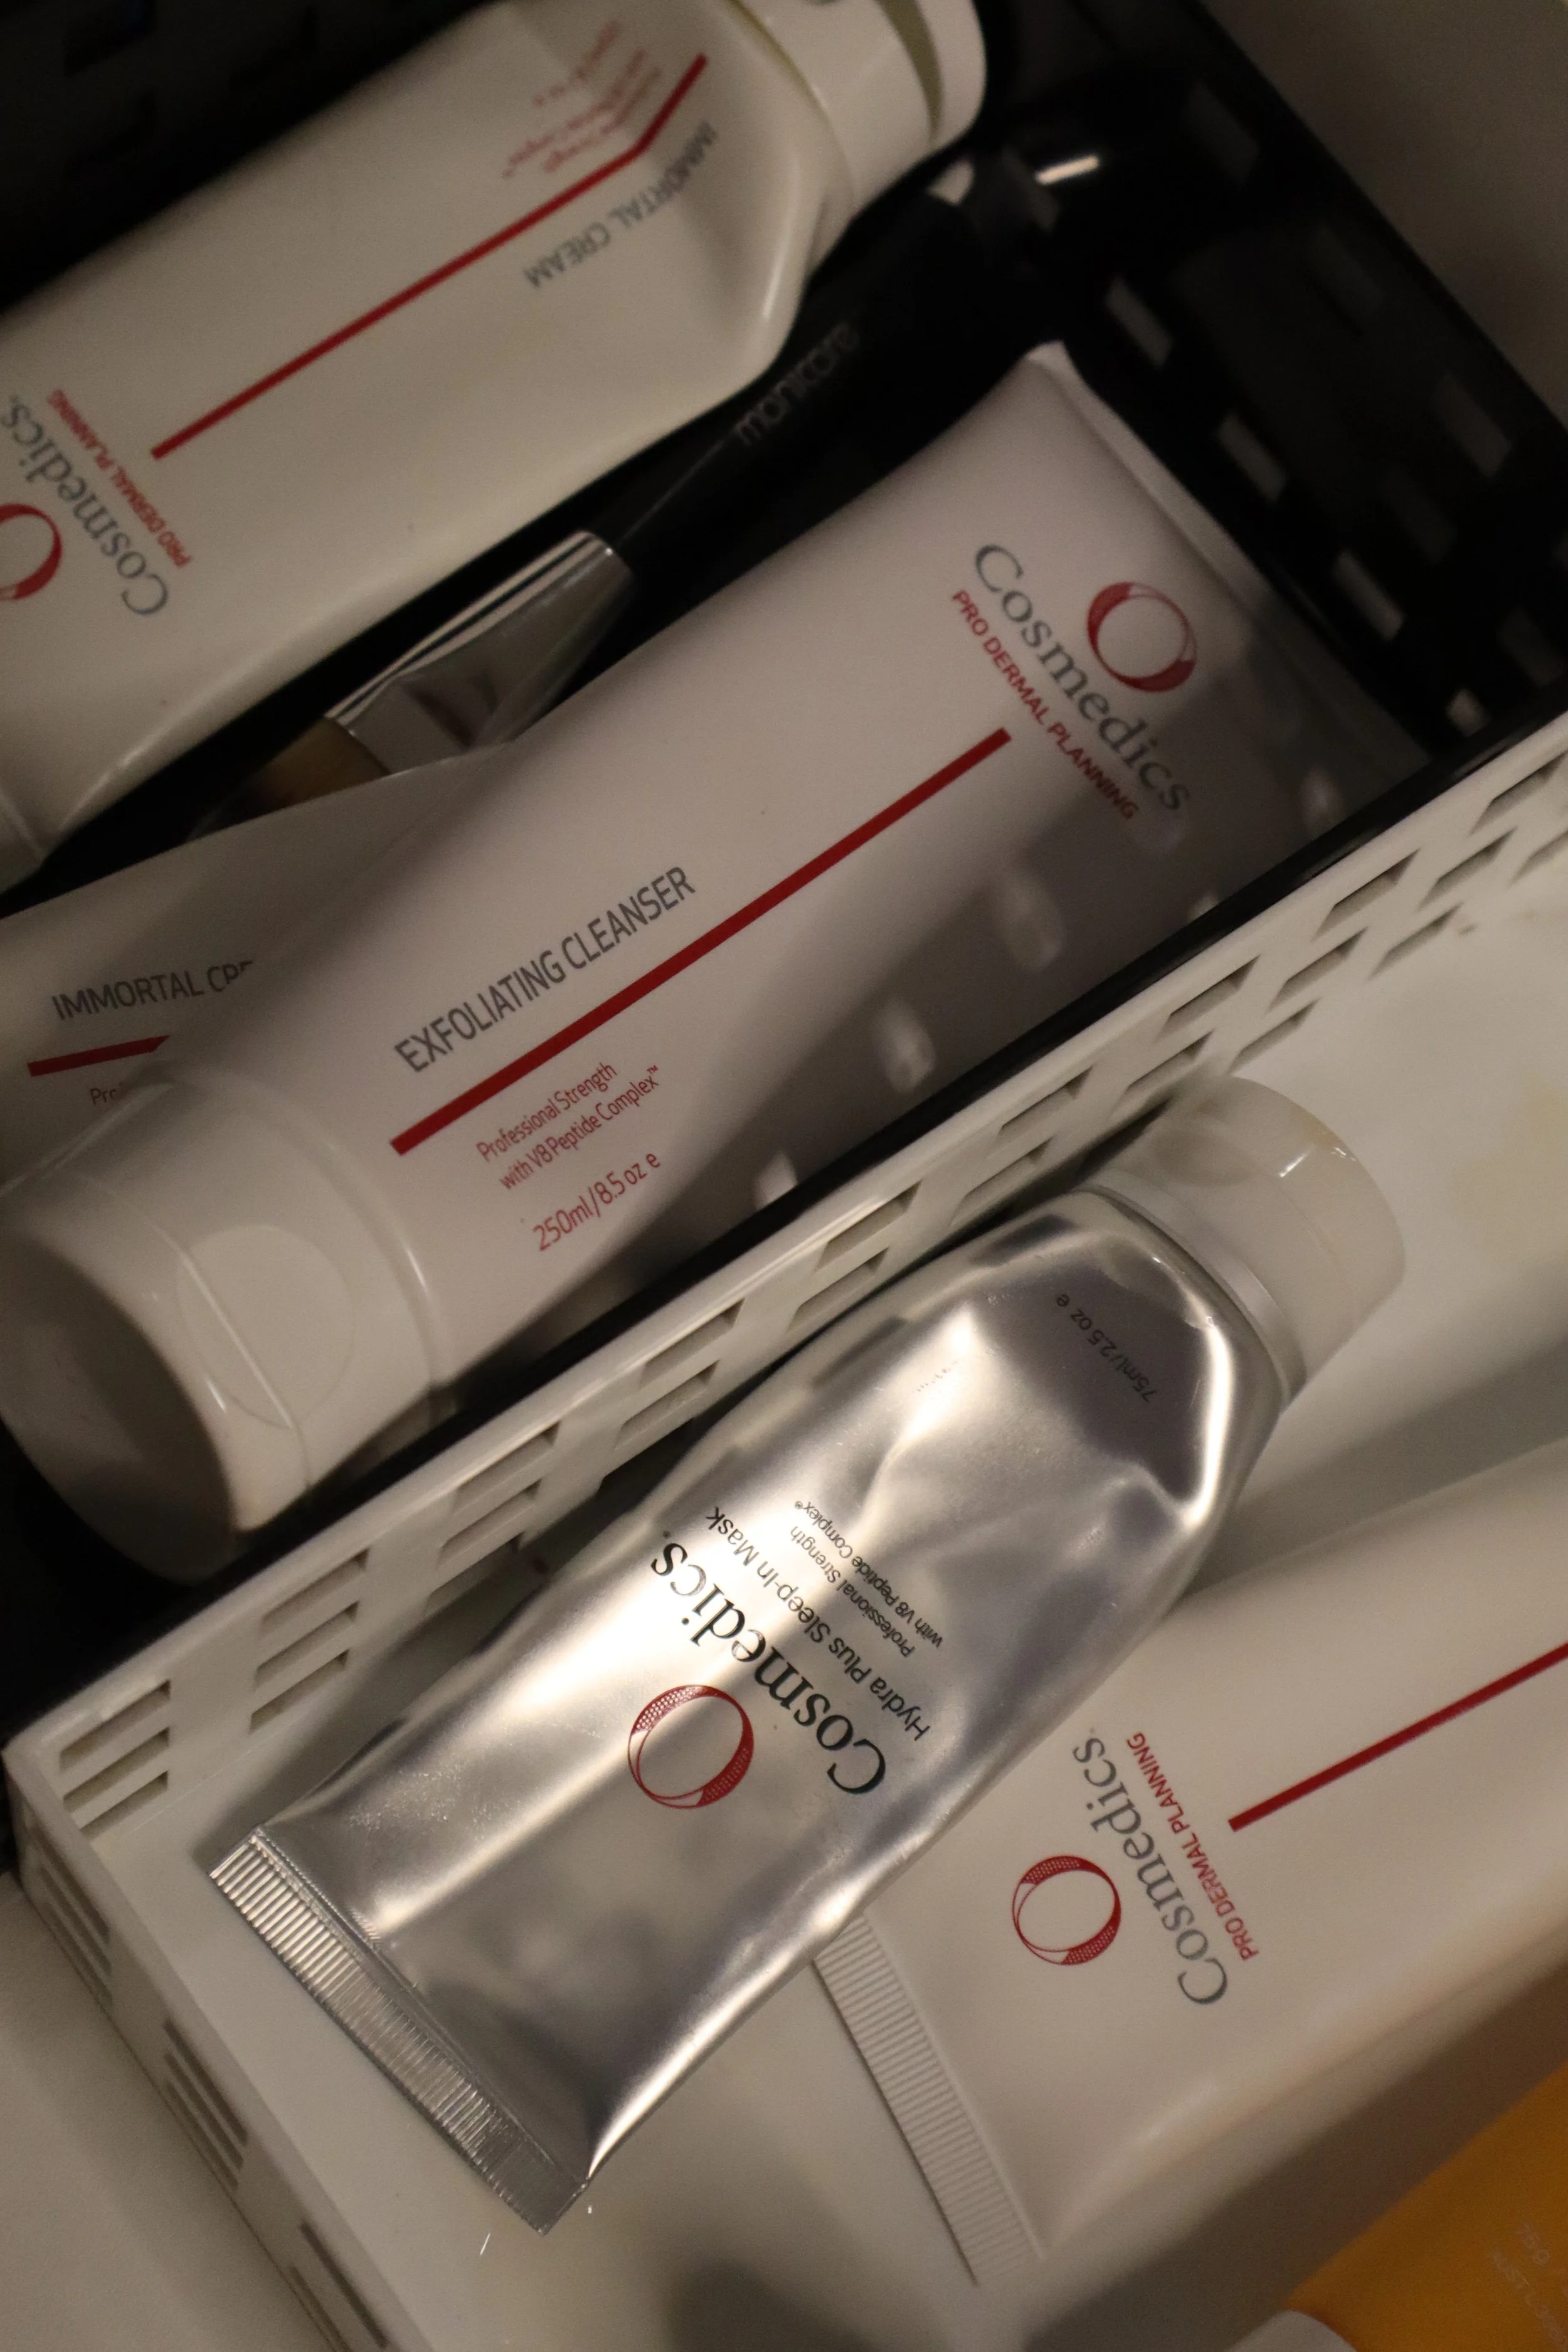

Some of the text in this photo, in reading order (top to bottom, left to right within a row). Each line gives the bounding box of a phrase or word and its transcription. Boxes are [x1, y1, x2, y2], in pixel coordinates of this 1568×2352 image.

[523, 221, 612, 289] CREAM
[1, 403, 168, 615] Cosmedics
[952, 589, 1140, 820] PRO DERMAL PLANNING
[975, 544, 1190, 810] Cosmedics
[51, 970, 205, 1021] IMMORTAL
[393, 866, 697, 1073] EXFOLIATING CLEANSER
[476, 1062, 618, 1162] Professional Strength
[499, 1160, 534, 1190] with
[526, 1143, 553, 1168] V8
[544, 1114, 602, 1156] Peptide
[532, 1170, 627, 1252] 250ml/8.5
[623, 1163, 648, 1185] oz
[1069, 1307, 1093, 1331] oz
[1087, 1329, 1158, 1403] 75ml/2.5
[705, 1507, 931, 1741] Hydra Plus Sleep-In Mask
[790, 1525, 916, 1658] Professional Strength
[851, 1555, 900, 1607] Peptide
[894, 1601, 915, 1624] V8
[650, 1542, 886, 1795] Cosmedics
[914, 1617, 943, 1649] with
[1072, 1736, 1228, 2005] Cosmedics
[1125, 1731, 1259, 1962] PRO DERMAL PLANNING
